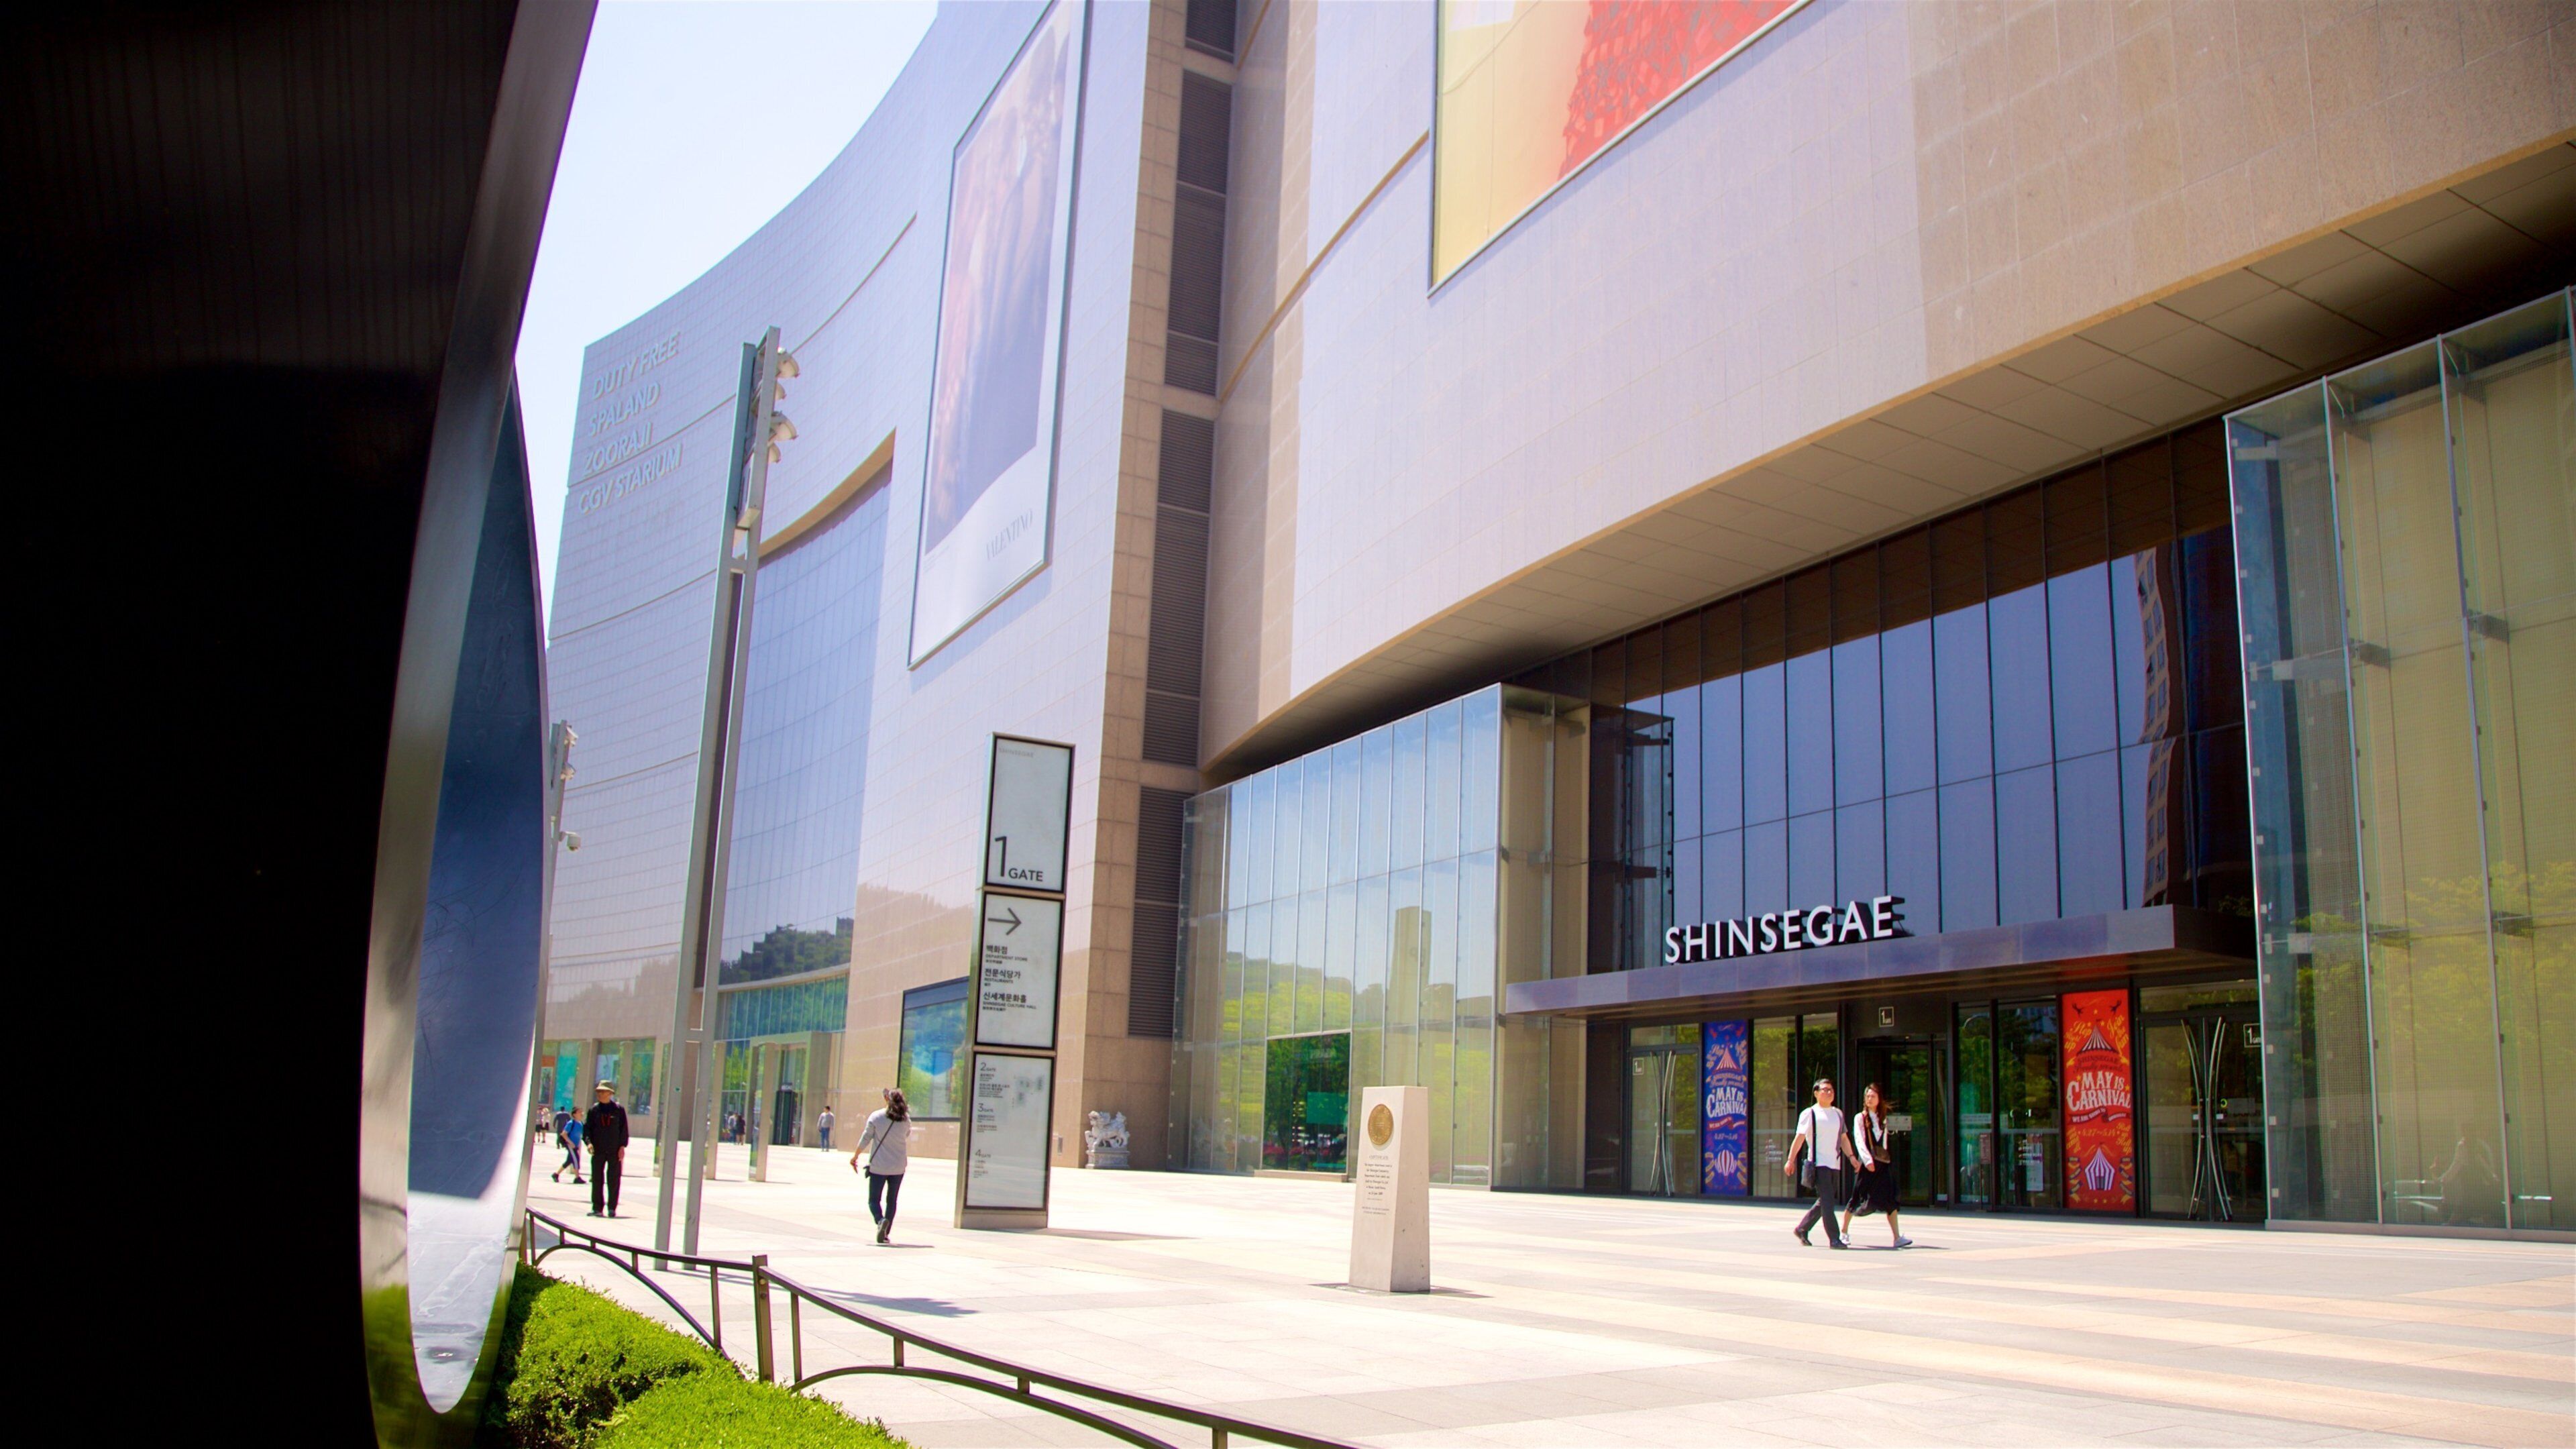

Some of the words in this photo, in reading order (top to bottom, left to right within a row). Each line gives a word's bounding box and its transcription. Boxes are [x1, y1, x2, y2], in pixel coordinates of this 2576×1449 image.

[592, 356, 639, 401] DUTY
[639, 331, 681, 376] FREE
[590, 382, 661, 437] SPALAND
[582, 421, 653, 477] ZOORAJI
[579, 478, 615, 515] CGV
[616, 441, 684, 498] STARIUM
[986, 508, 1033, 561] VALENTINO
[994, 836, 1007, 877] 1
[1008, 867, 1044, 882] GATE
[1664, 895, 1898, 964] SHINSEGAE
[986, 945, 1008, 955] 백화점
[985, 968, 1021, 979] 전문식당가
[983, 991, 1026, 1004] 신세계문화홀
[980, 1062, 987, 1071] 2
[2081, 1071, 2113, 1090] MAY
[2114, 1075, 2125, 1091] IS
[1706, 1093, 1747, 1118] CARNIVAL
[1716, 1086, 1737, 1101] MAY
[1737, 1090, 1744, 1102] IS
[2067, 1080, 2131, 1112] CARNIVAL
[978, 1103, 983, 1112] 3
[975, 1148, 981, 1157] 4
